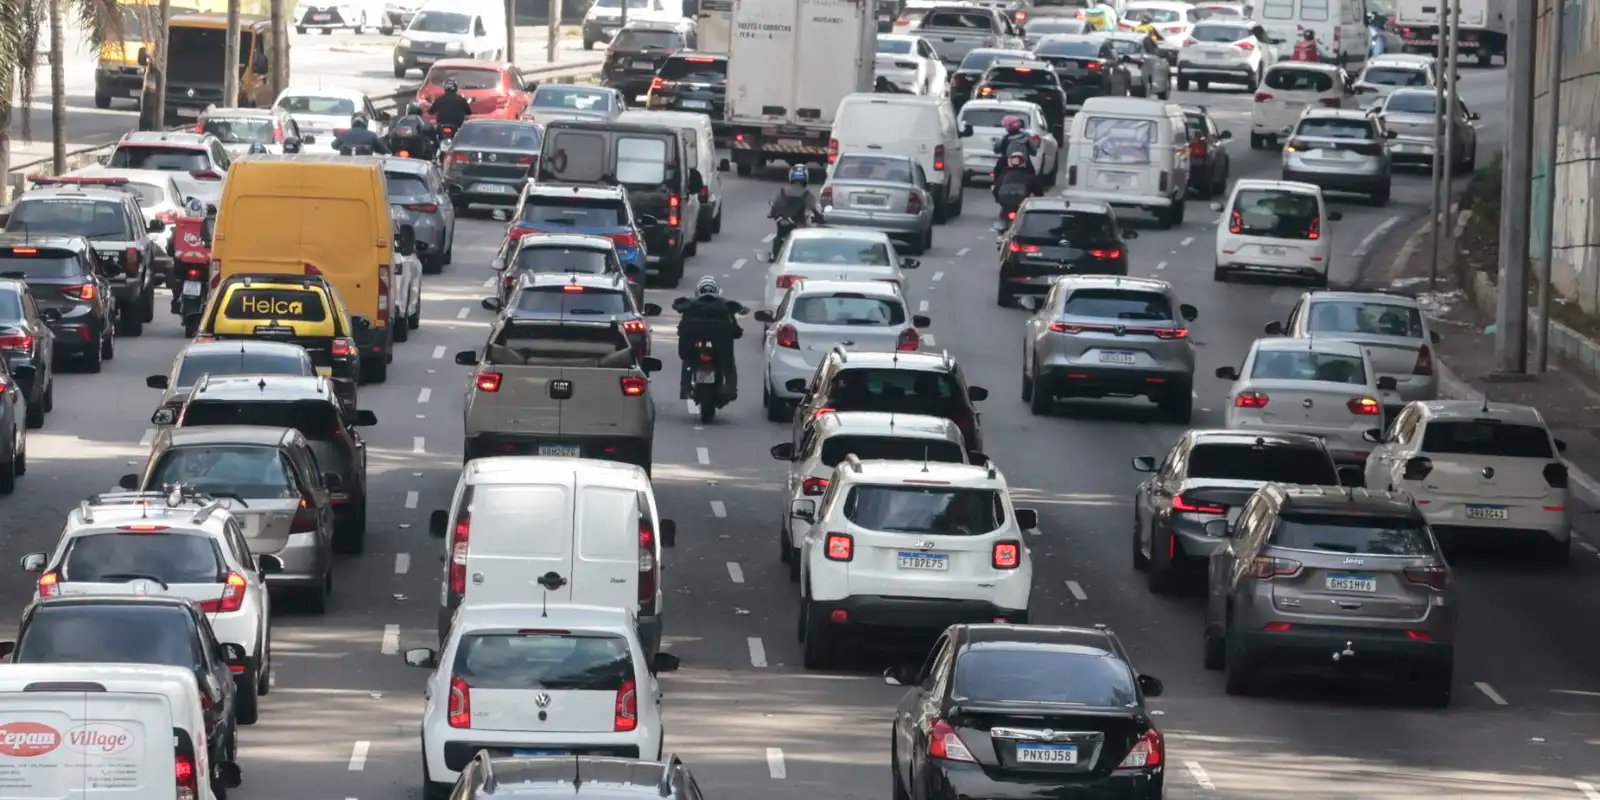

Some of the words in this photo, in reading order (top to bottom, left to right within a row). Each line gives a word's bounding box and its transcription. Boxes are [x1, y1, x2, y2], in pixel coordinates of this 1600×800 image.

[242, 296, 303, 314] Helca
[1343, 557, 1364, 566] Jeep
[1330, 578, 1371, 590] GHS1H96
[70, 731, 127, 751] Village
